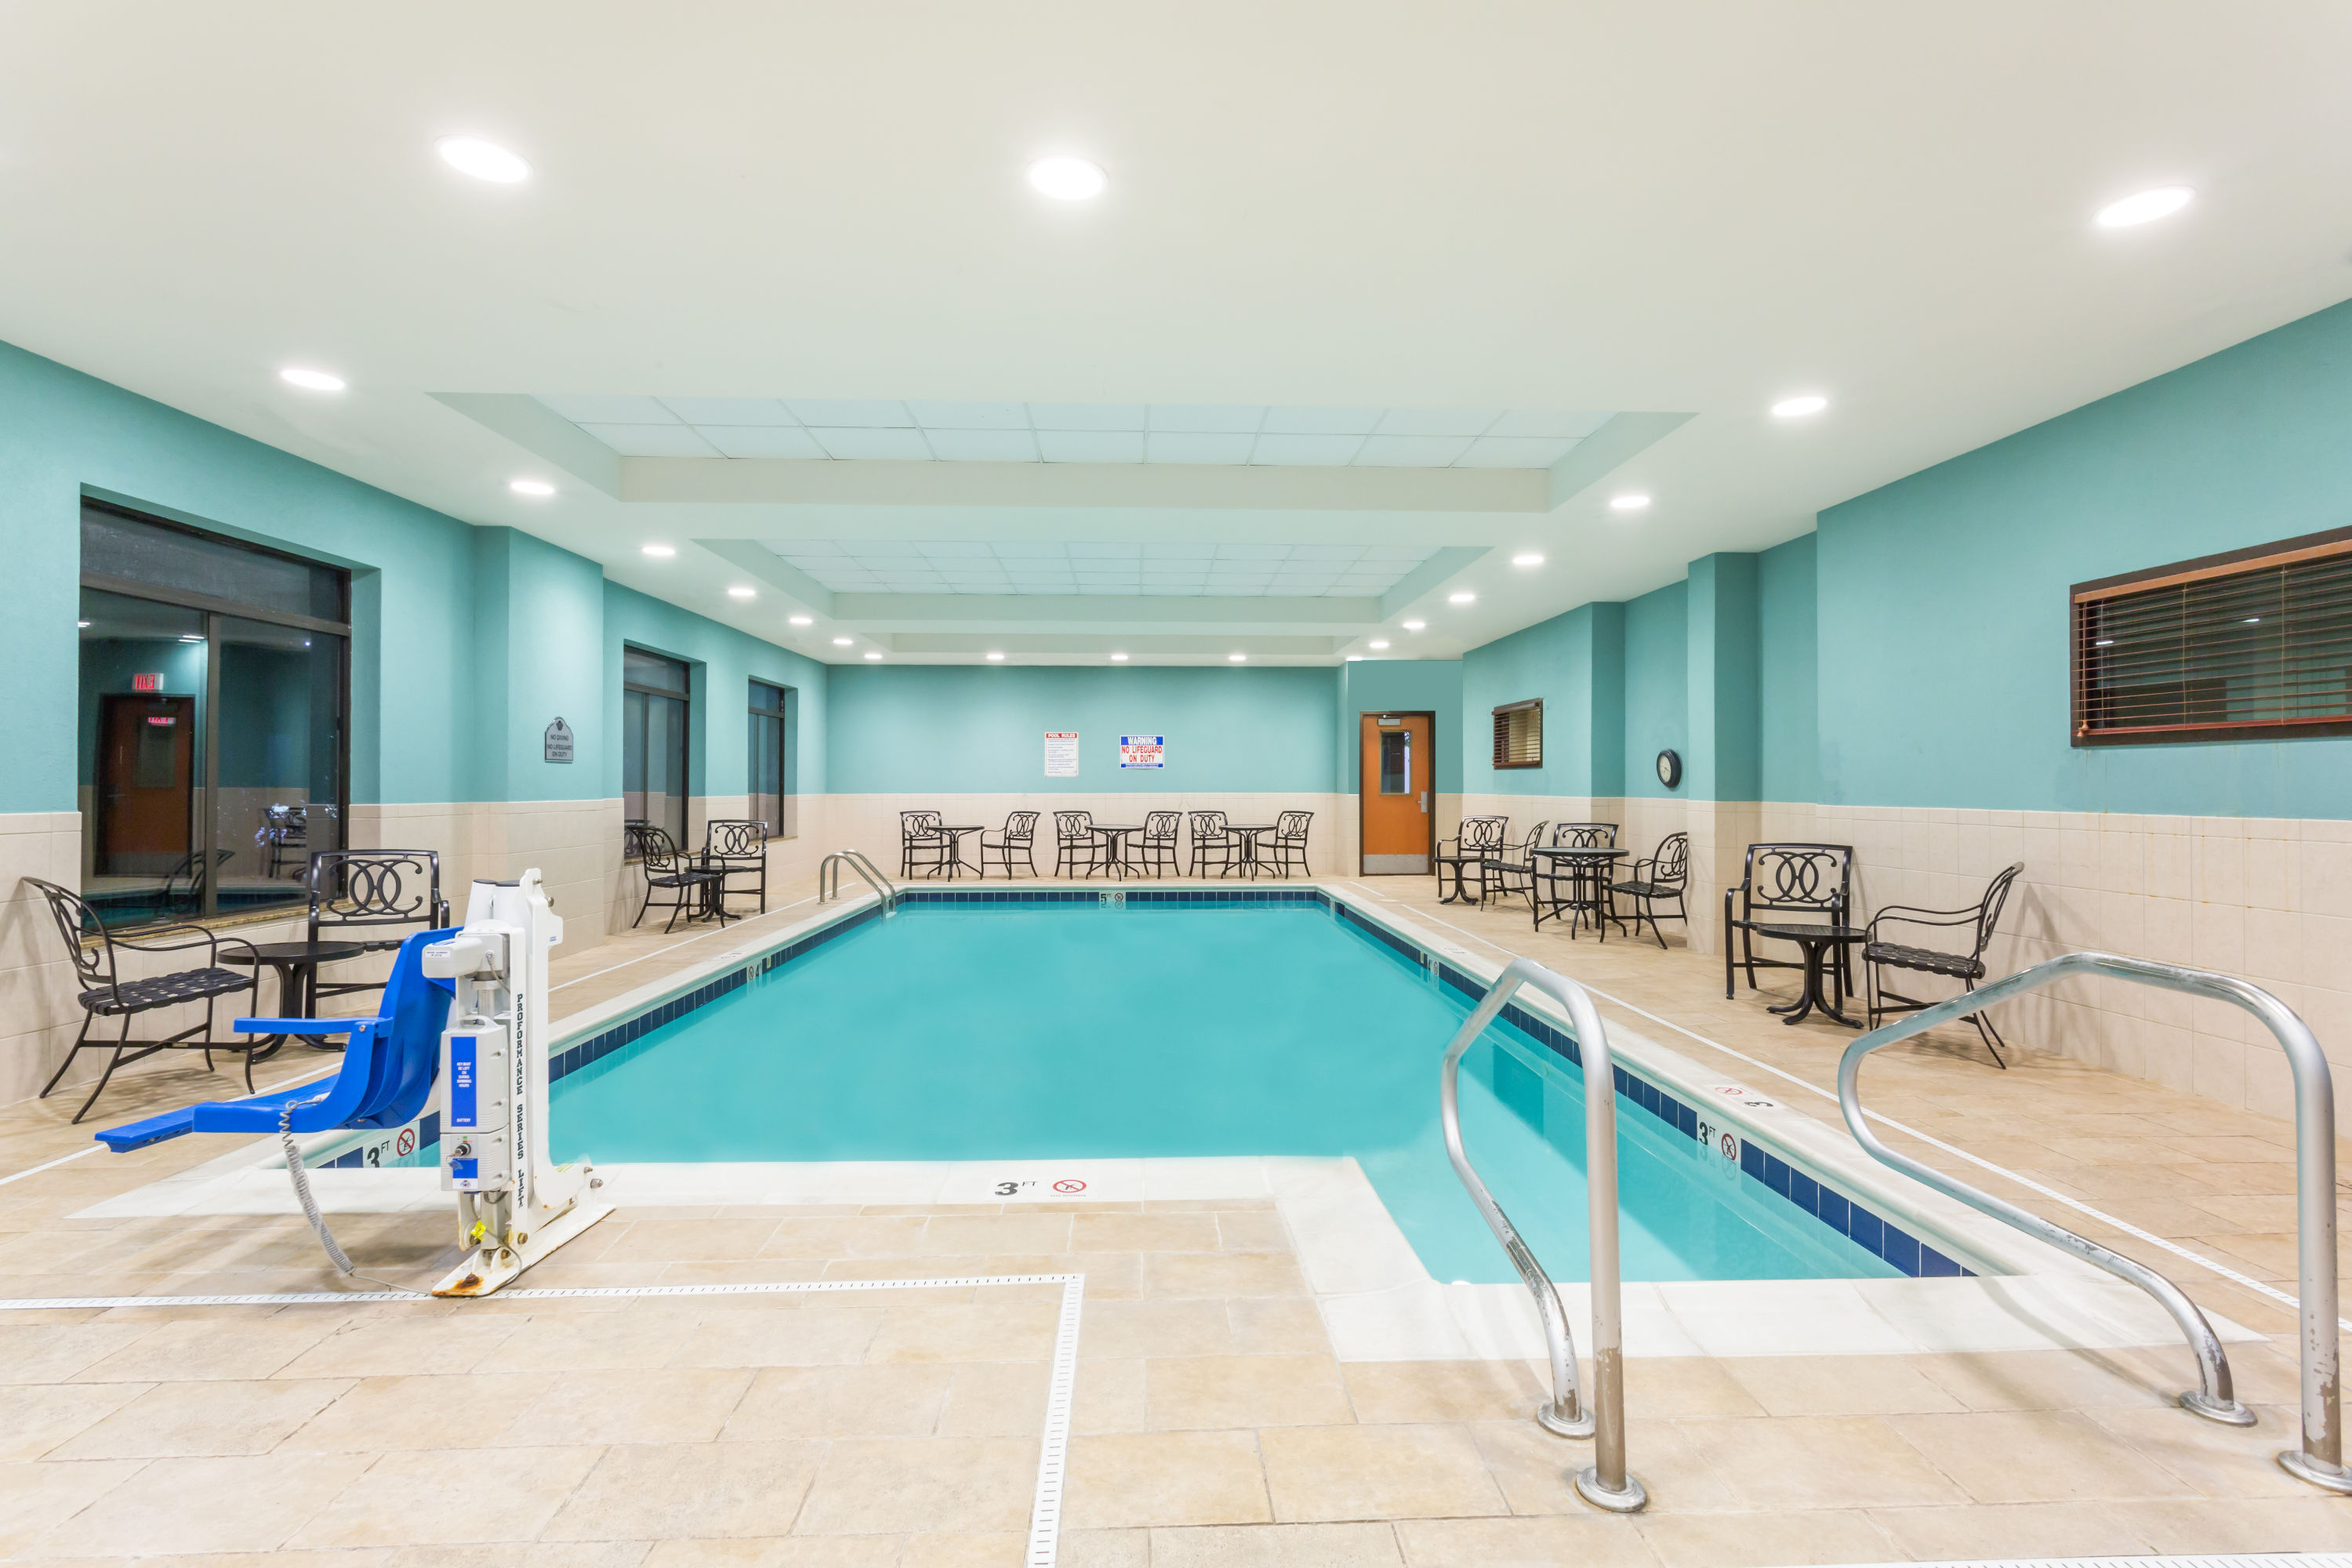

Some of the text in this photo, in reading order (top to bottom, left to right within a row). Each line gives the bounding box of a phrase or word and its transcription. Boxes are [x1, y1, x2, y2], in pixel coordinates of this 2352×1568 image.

[1101, 894, 1106, 902] 5
[1699, 1121, 1716, 1145] 3 FT
[381, 1140, 390, 1153] FT
[994, 1181, 1018, 1196] 3
